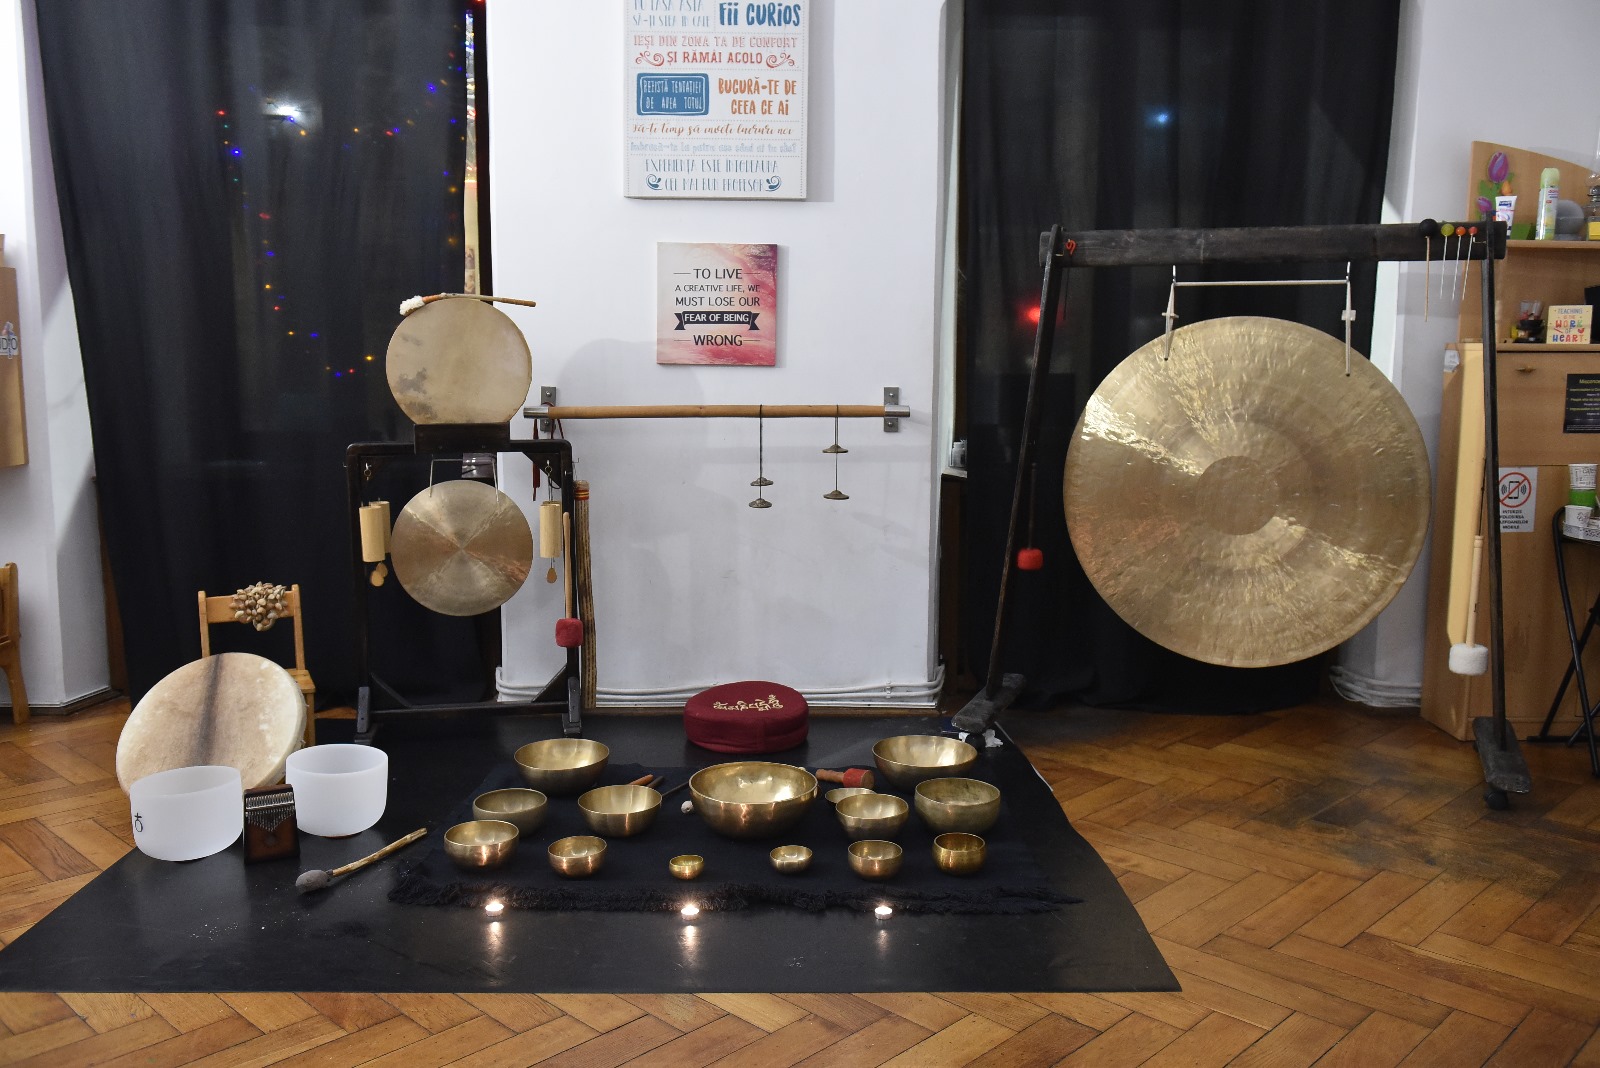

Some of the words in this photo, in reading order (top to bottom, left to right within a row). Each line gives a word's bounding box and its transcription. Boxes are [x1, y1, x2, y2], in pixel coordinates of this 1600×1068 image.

[658, 35, 678, 47] DIN
[681, 36, 710, 47] ZONA
[714, 36, 728, 47] TA
[732, 36, 745, 48] DE
[749, 37, 799, 49] CONFORT
[727, 52, 763, 64] ACOLO
[785, 80, 798, 95] DE
[645, 97, 654, 109] DE
[761, 100, 773, 115] CE
[701, 160, 721, 172] ESTE
[682, 178, 698, 191] MAI
[702, 178, 718, 191] BUN
[722, 178, 765, 192] PROFESOR
[693, 268, 711, 280] TO
[715, 268, 743, 280] LIVE
[674, 284, 681, 292] A
[683, 284, 723, 292] CREATIVE
[726, 284, 745, 294] LIFE,
[748, 284, 761, 292] WE
[675, 296, 705, 306] MUST
[708, 296, 735, 306] LOSE
[739, 296, 760, 306] OUR
[684, 313, 707, 322] FEAR
[709, 313, 721, 322] OF
[723, 313, 749, 322] BEING
[1555, 320, 1583, 328] WORK
[693, 334, 743, 346] WRONG
